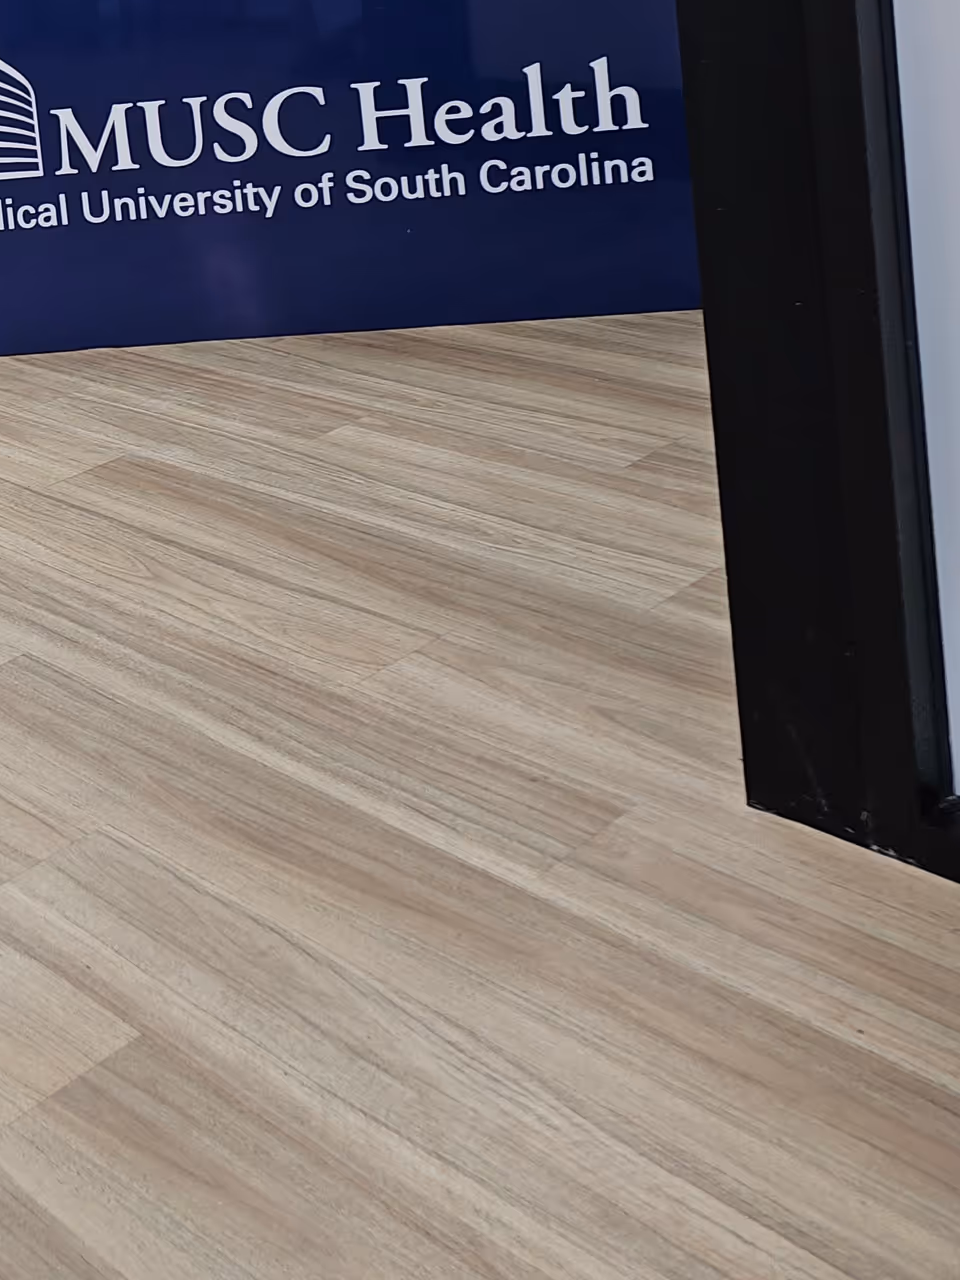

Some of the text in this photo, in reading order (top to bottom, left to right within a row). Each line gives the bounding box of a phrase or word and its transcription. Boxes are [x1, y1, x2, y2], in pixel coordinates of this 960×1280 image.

[49, 56, 649, 176] MUSC Health
[81, 182, 282, 226] University
[294, 172, 335, 208] of
[345, 164, 466, 204] South
[479, 151, 654, 194] Carolina
